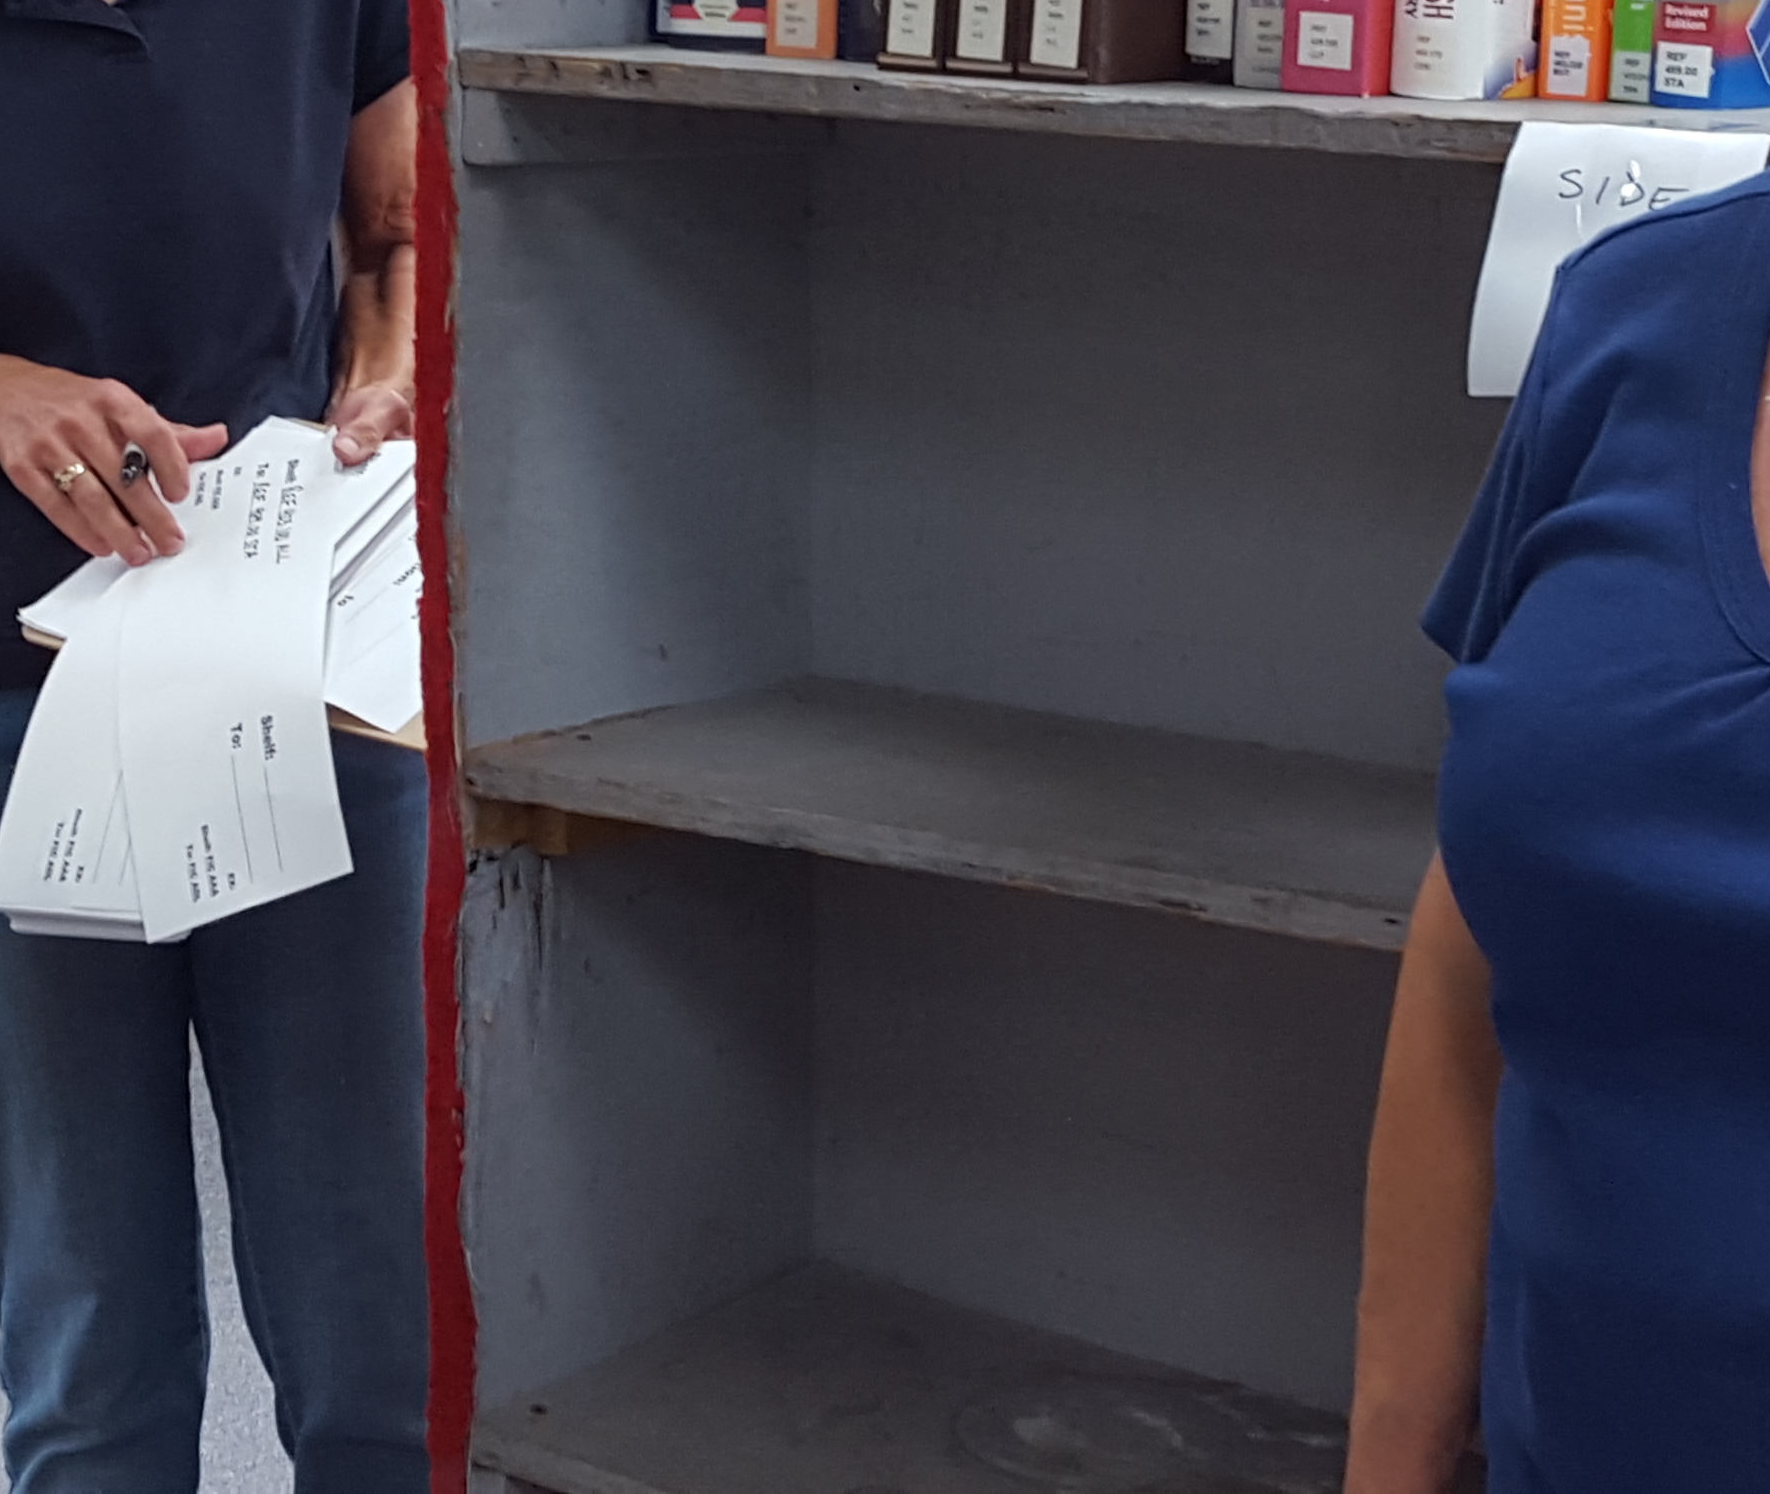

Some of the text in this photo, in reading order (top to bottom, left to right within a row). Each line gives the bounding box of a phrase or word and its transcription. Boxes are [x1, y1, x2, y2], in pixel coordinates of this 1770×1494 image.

[1664, 2, 1709, 18] Revised
[1664, 17, 1707, 32] Edition
[1558, 168, 1689, 212] SIDE
[229, 722, 243, 749] To:
[260, 714, 277, 762] Shelf:
[208, 873, 220, 898] AAA
